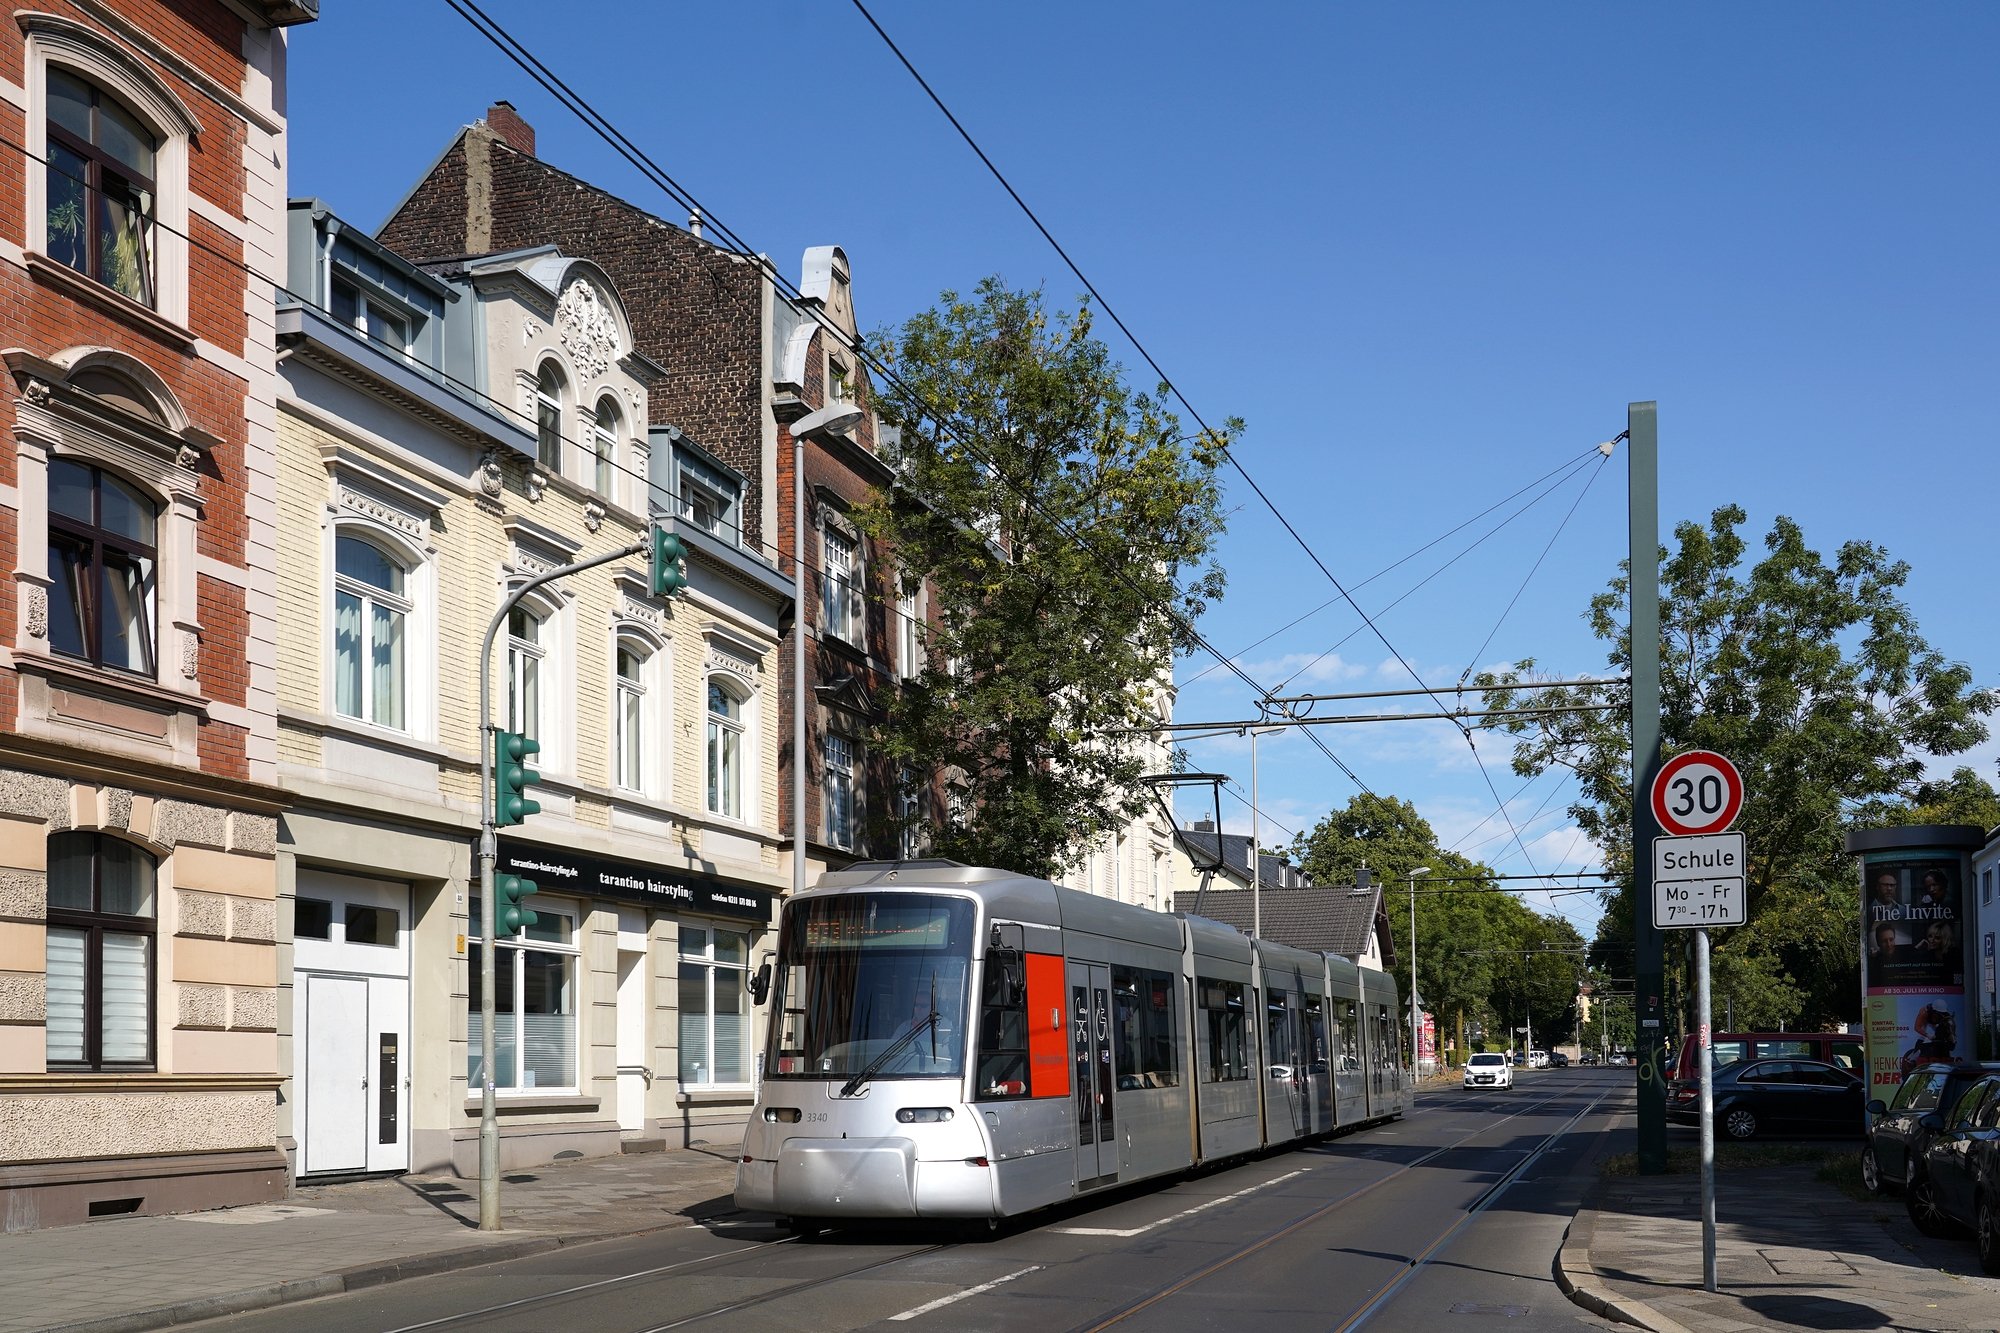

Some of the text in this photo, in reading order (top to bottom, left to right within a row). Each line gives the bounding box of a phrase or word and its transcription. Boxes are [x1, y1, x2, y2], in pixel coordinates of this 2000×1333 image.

[1671, 775, 1722, 816] 30
[510, 858, 578, 878] tarantino-hairstyling.de
[1663, 849, 1734, 870] Schule
[599, 872, 694, 901] tarantino hairstyling
[1666, 887, 1689, 901] Mo
[1713, 885, 1731, 899] Fr
[711, 893, 728, 903] telefon
[728, 895, 738, 905] 0211
[1872, 903, 1954, 922] The Invite.
[1873, 1056, 1904, 1070] HENKE
[1873, 1072, 1902, 1085] DER
[807, 1112, 828, 1122] 3340
